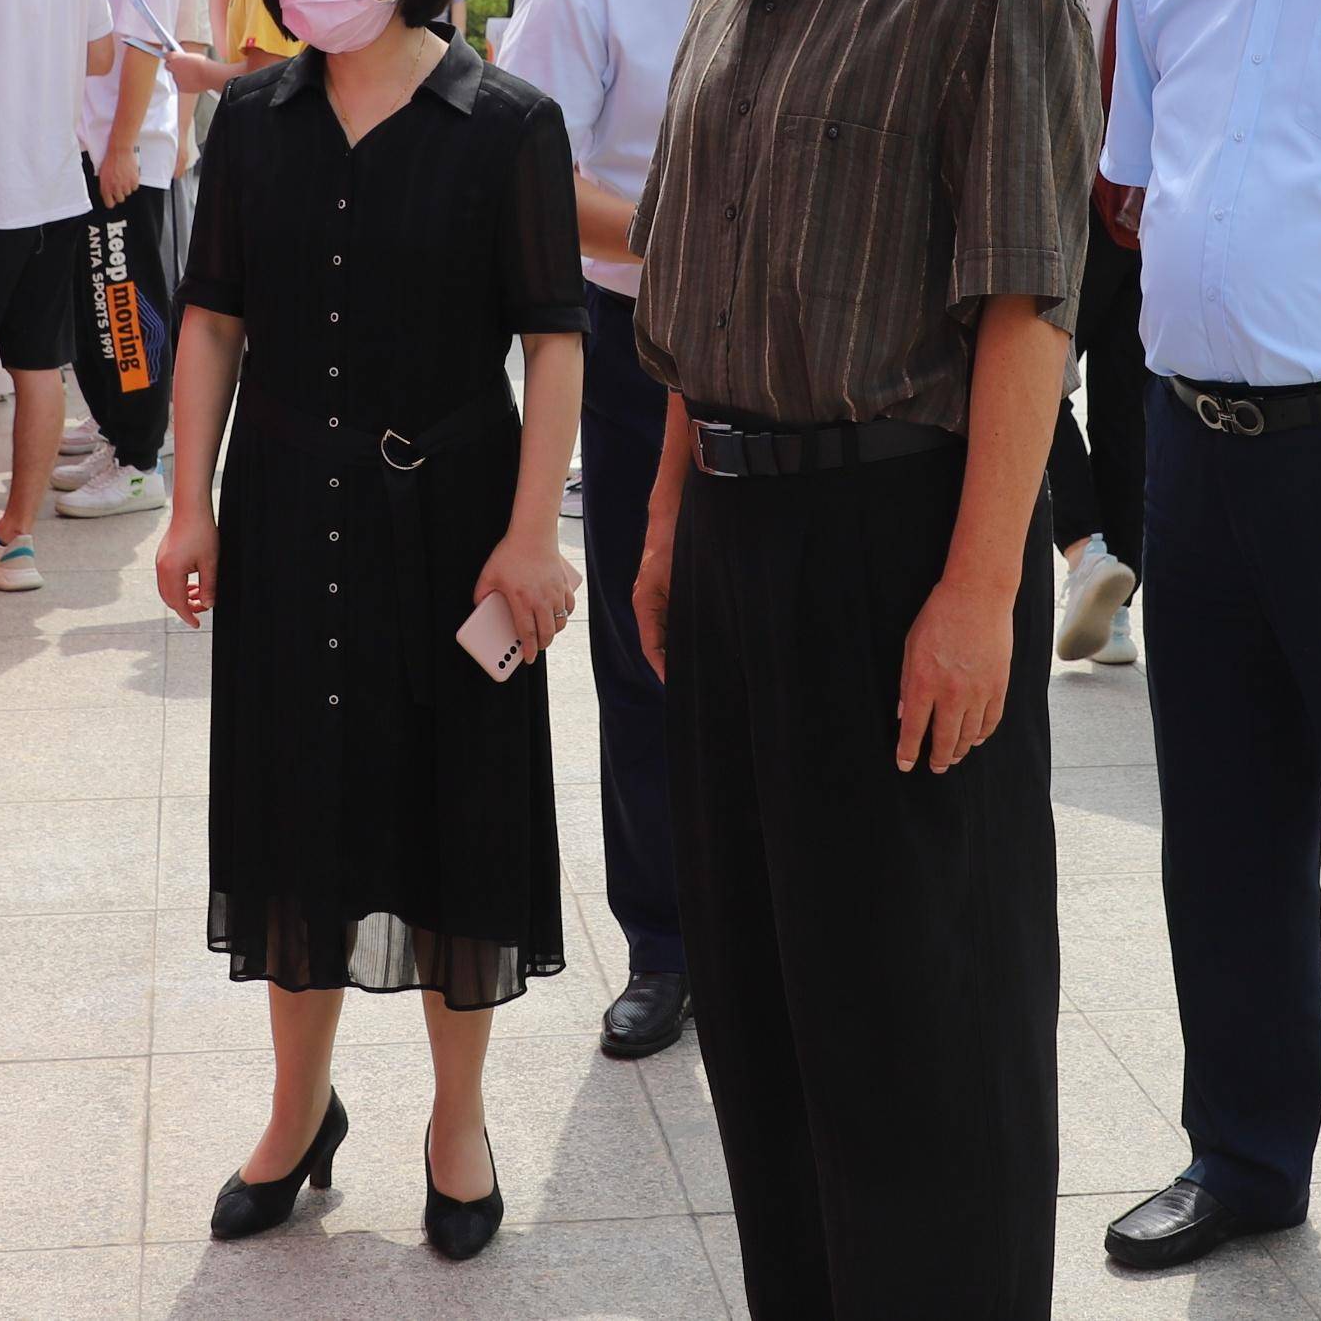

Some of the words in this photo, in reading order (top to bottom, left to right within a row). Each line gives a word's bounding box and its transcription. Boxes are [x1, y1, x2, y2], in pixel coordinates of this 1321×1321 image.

[88, 225, 103, 269] ANTA
[106, 219, 128, 283] keep
[92, 273, 110, 329] SPORTS
[100, 332, 115, 360] 1991
[112, 285, 141, 374] moving
